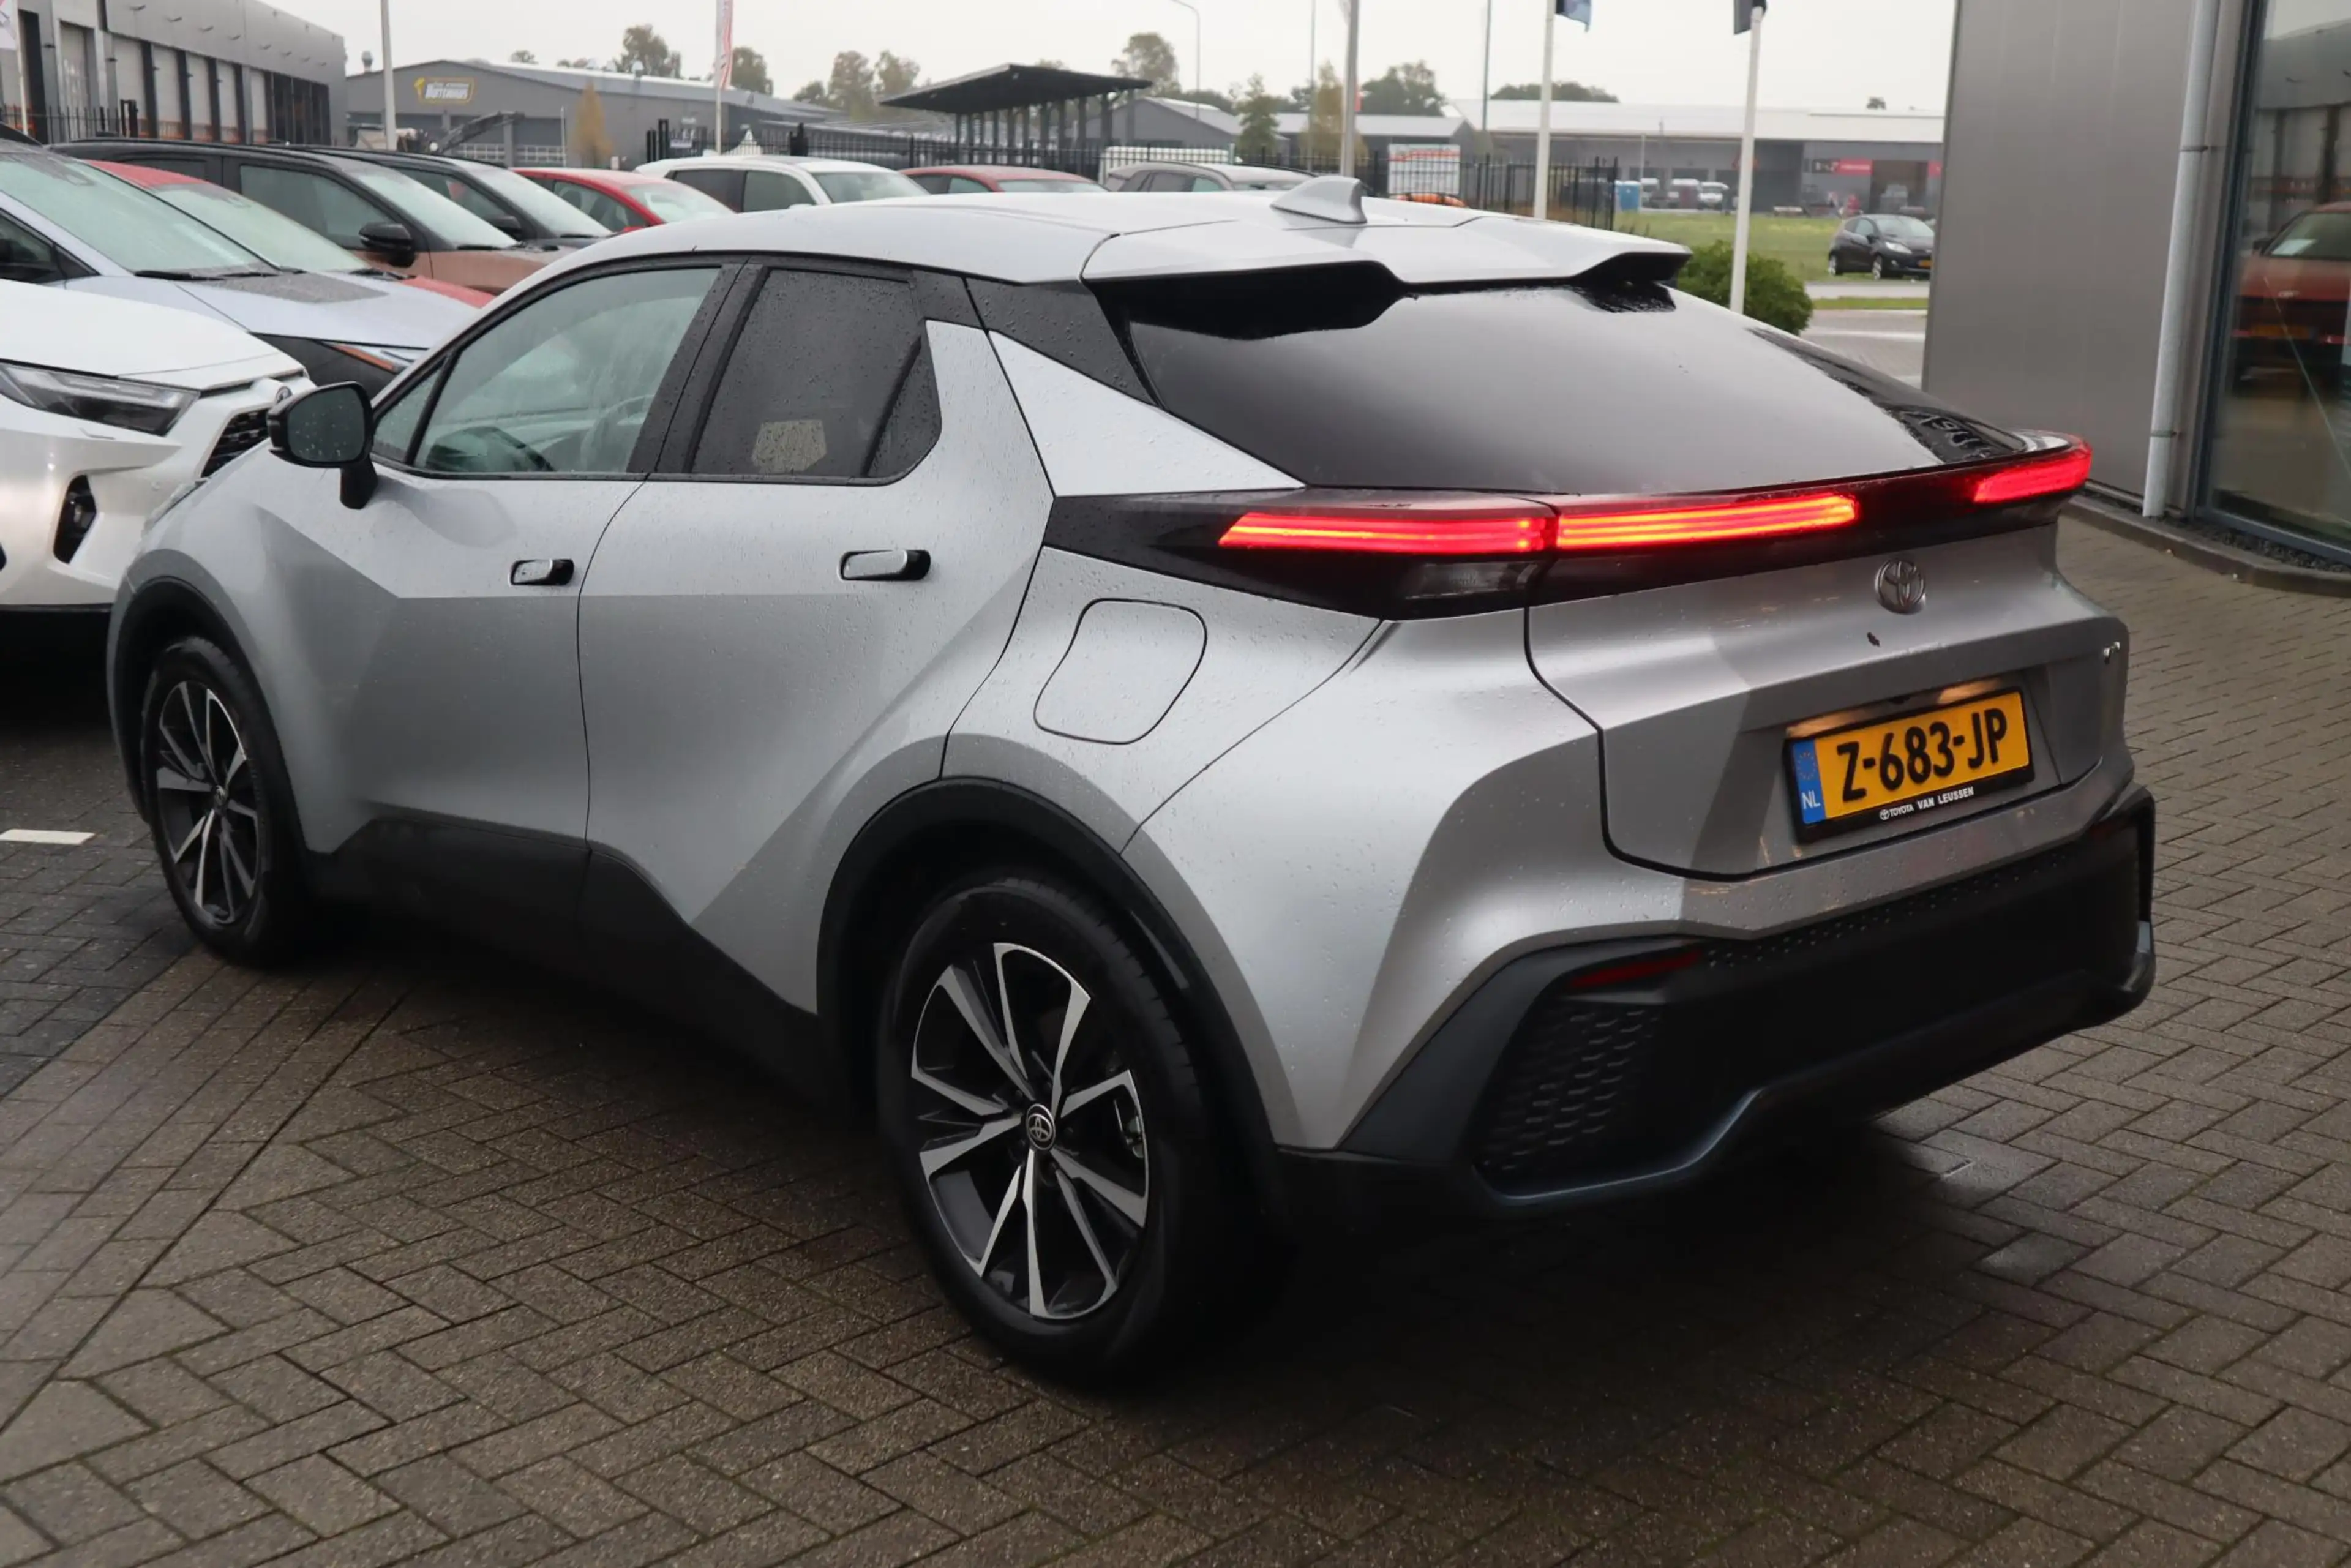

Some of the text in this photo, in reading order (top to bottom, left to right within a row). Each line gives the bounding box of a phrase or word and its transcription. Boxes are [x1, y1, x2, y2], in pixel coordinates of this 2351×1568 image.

[1837, 708, 2007, 801] Z-683-JP
[1802, 790, 1821, 809] NL
[1889, 786, 1974, 817] TOYOTA VAN LEUSSEN
